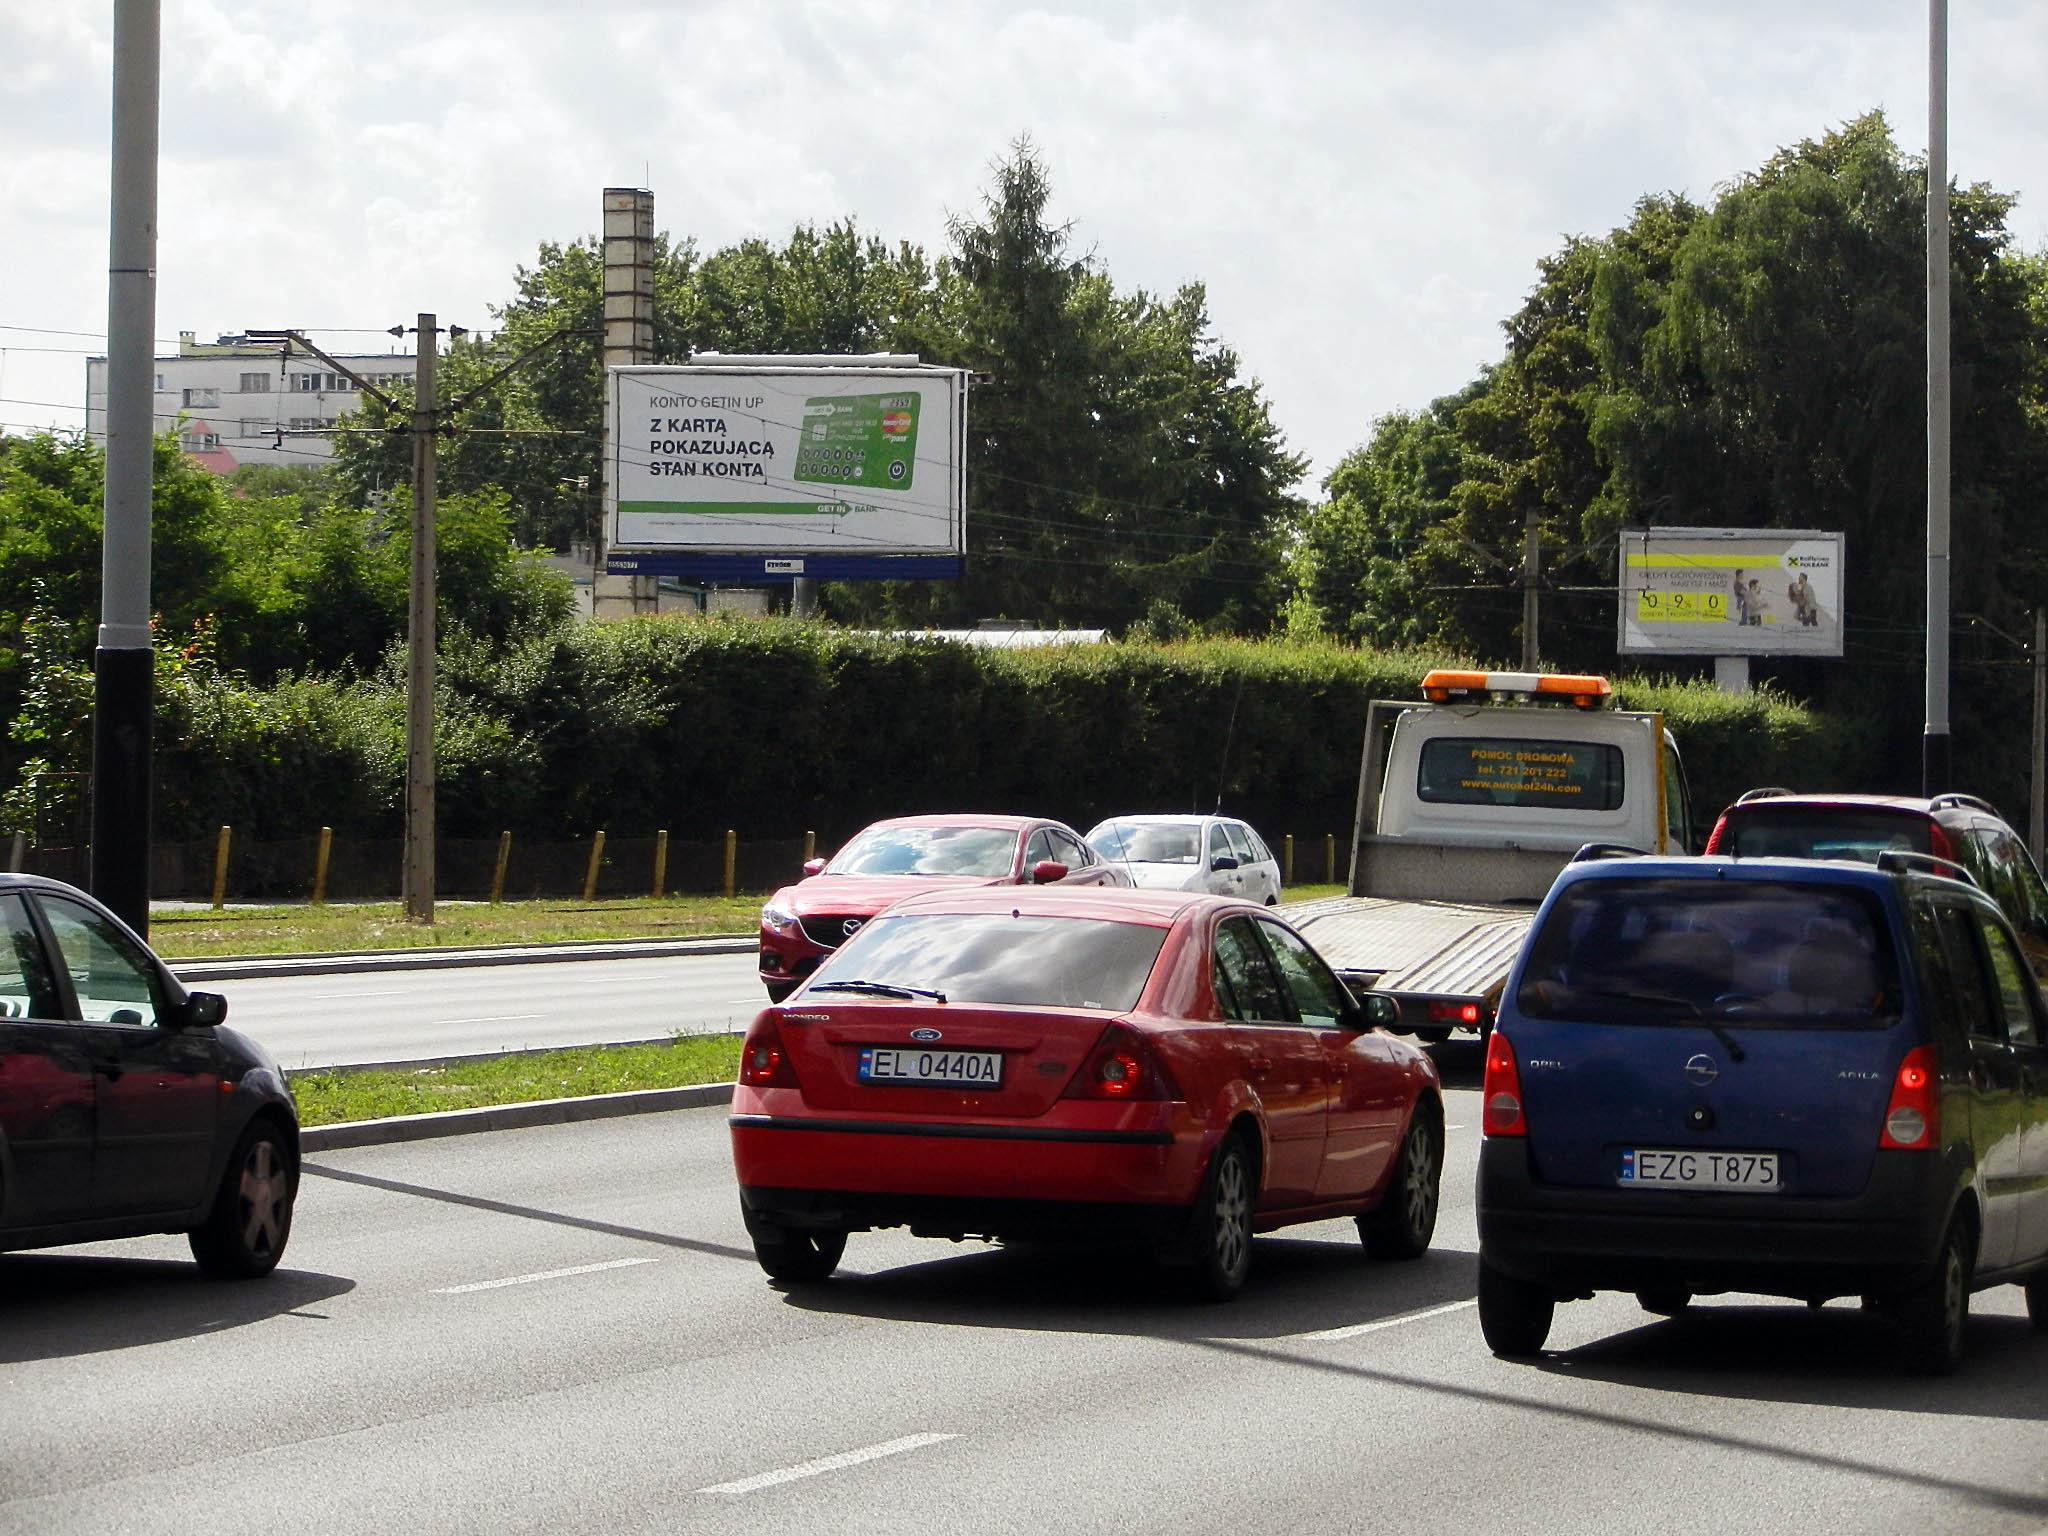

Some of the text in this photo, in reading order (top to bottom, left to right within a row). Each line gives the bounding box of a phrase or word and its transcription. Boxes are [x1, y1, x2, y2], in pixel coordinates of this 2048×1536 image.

[650, 396, 764, 408] KONTO GETIN UP
[650, 418, 727, 437] Z KARTĄ
[650, 440, 775, 459] POKAZUJĄCĄ
[649, 461, 764, 477] STAN KONTA
[1708, 594, 1719, 609] 0
[1471, 750, 1513, 761] POMOC
[1477, 764, 1568, 778] tel. 721 201 222
[873, 1051, 995, 1081] EL 0440A
[1638, 1153, 1775, 1185] EZG T875
